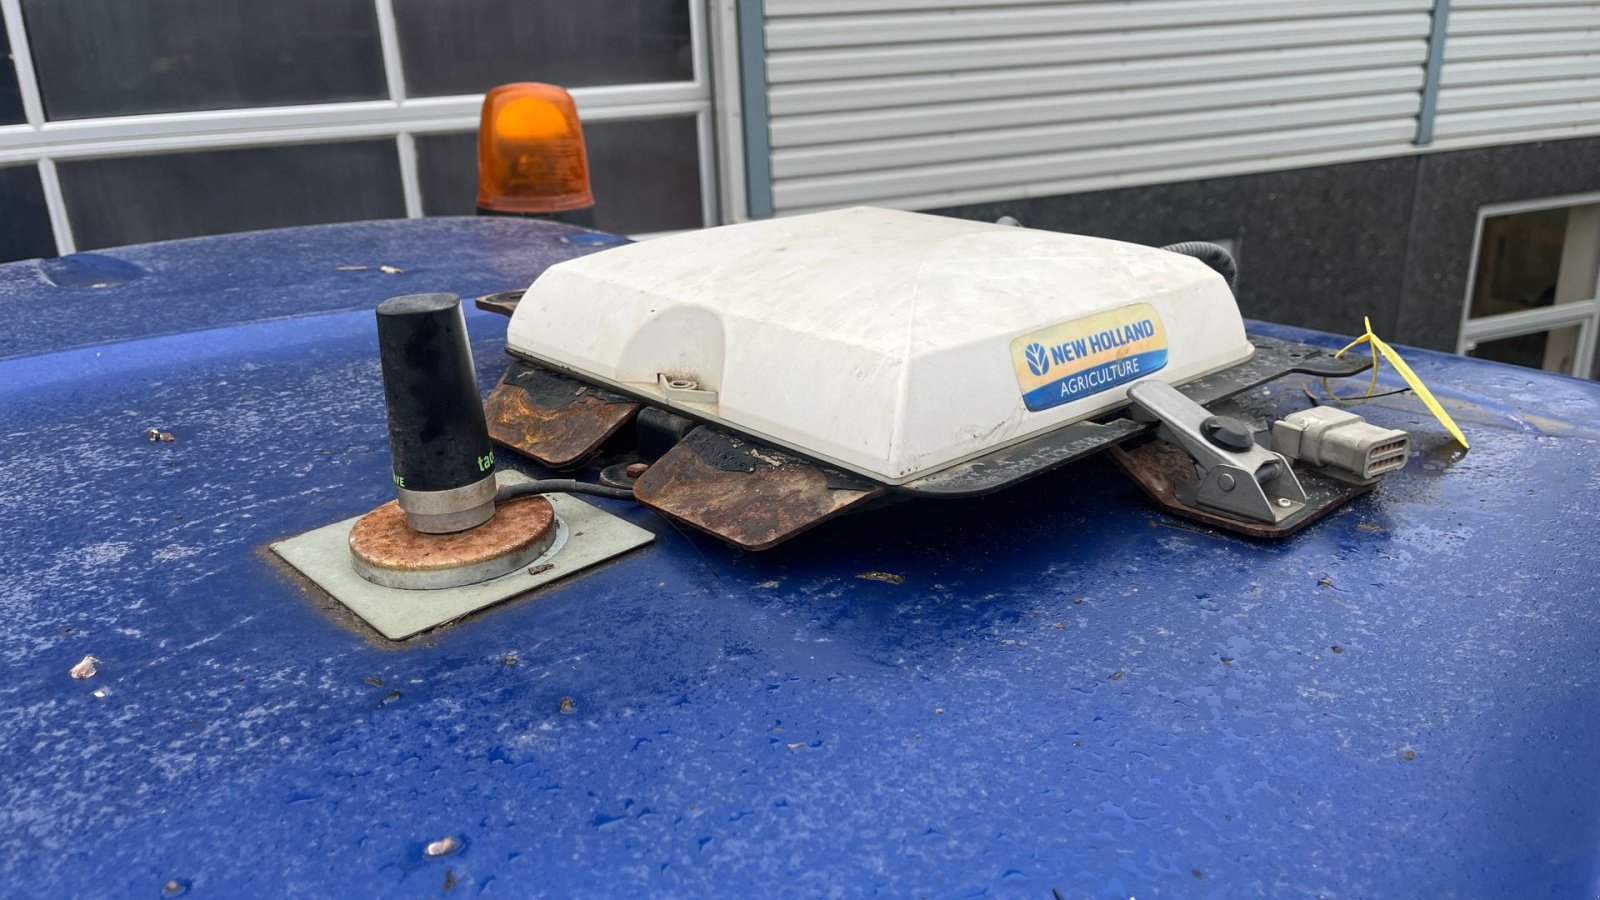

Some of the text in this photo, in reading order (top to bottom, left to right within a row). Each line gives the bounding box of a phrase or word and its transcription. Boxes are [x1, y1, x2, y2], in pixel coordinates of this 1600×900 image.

[1051, 319, 1154, 365] NEW HOLLAND
[1061, 358, 1140, 397] AGRICULTURE
